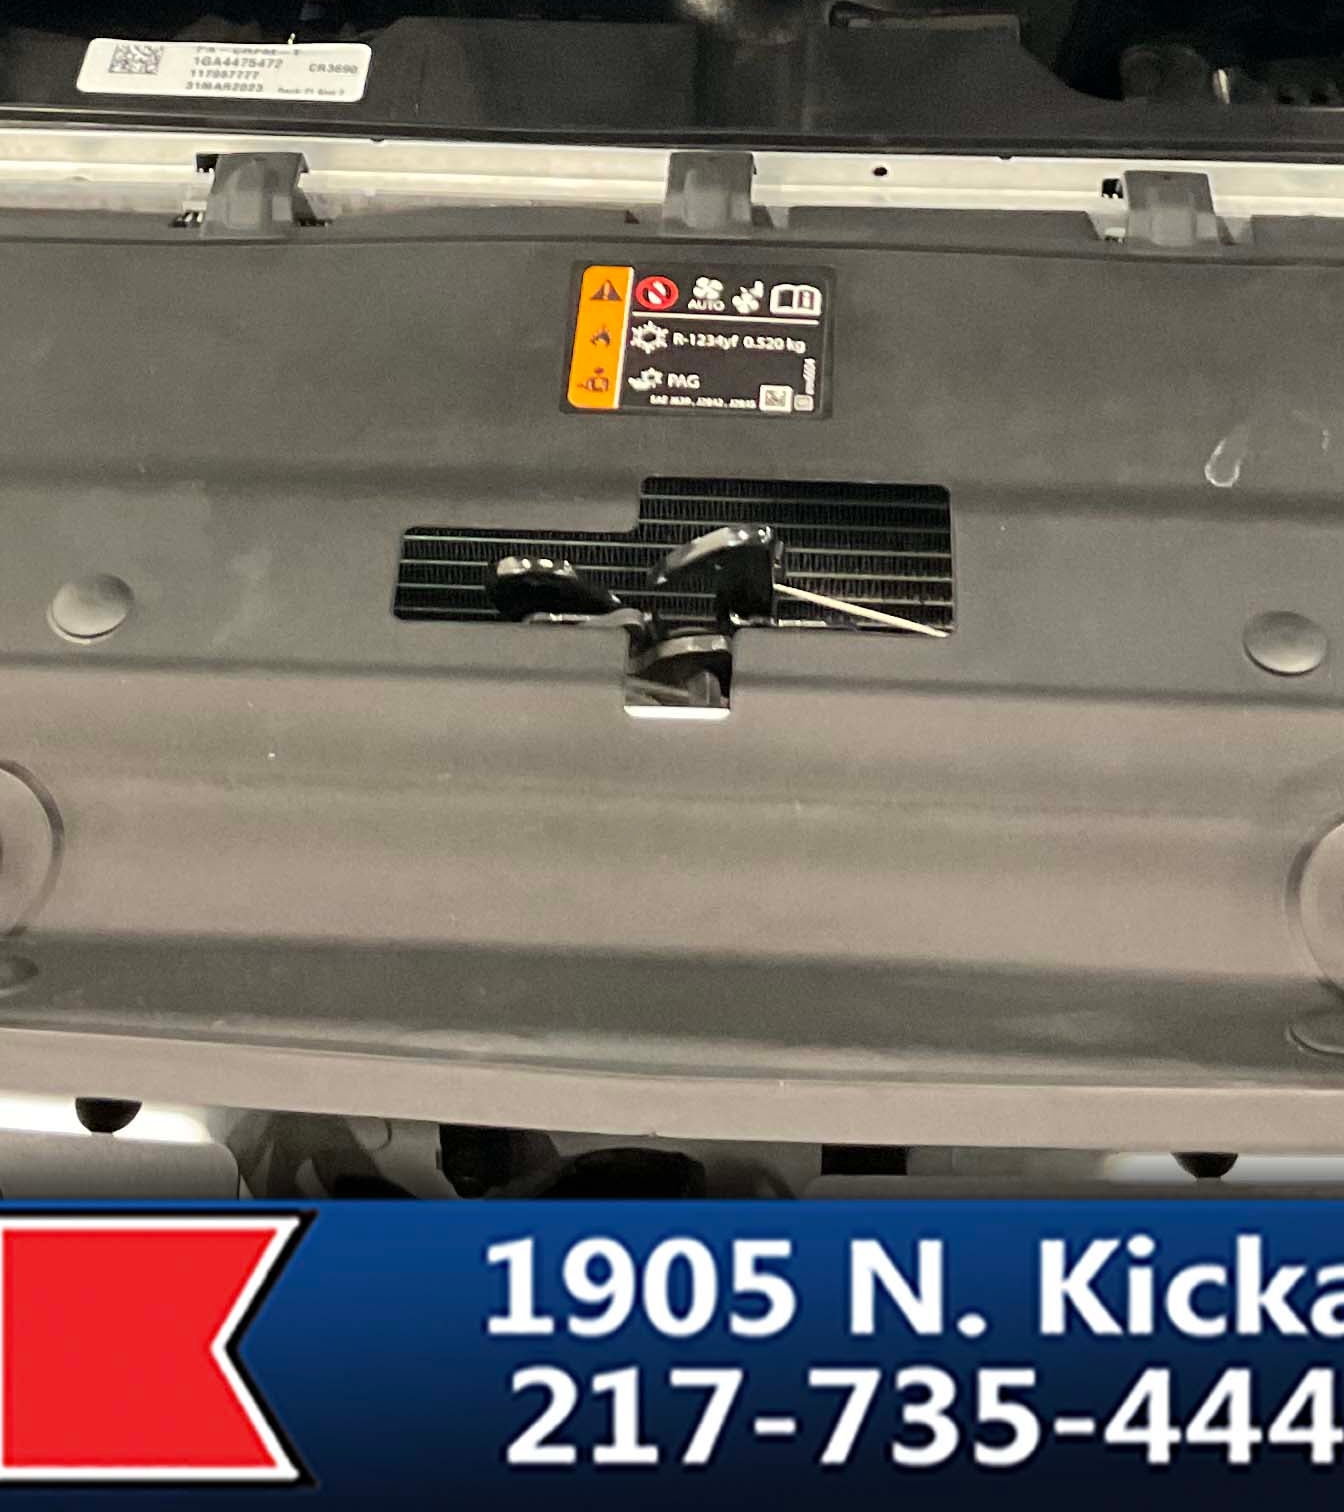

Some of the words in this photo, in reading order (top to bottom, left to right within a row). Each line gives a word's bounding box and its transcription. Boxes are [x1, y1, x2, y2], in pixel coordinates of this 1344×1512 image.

[688, 299, 725, 312] AUTO
[672, 332, 739, 351] R-1234yf
[786, 337, 806, 355] kg
[667, 373, 701, 389] PAG
